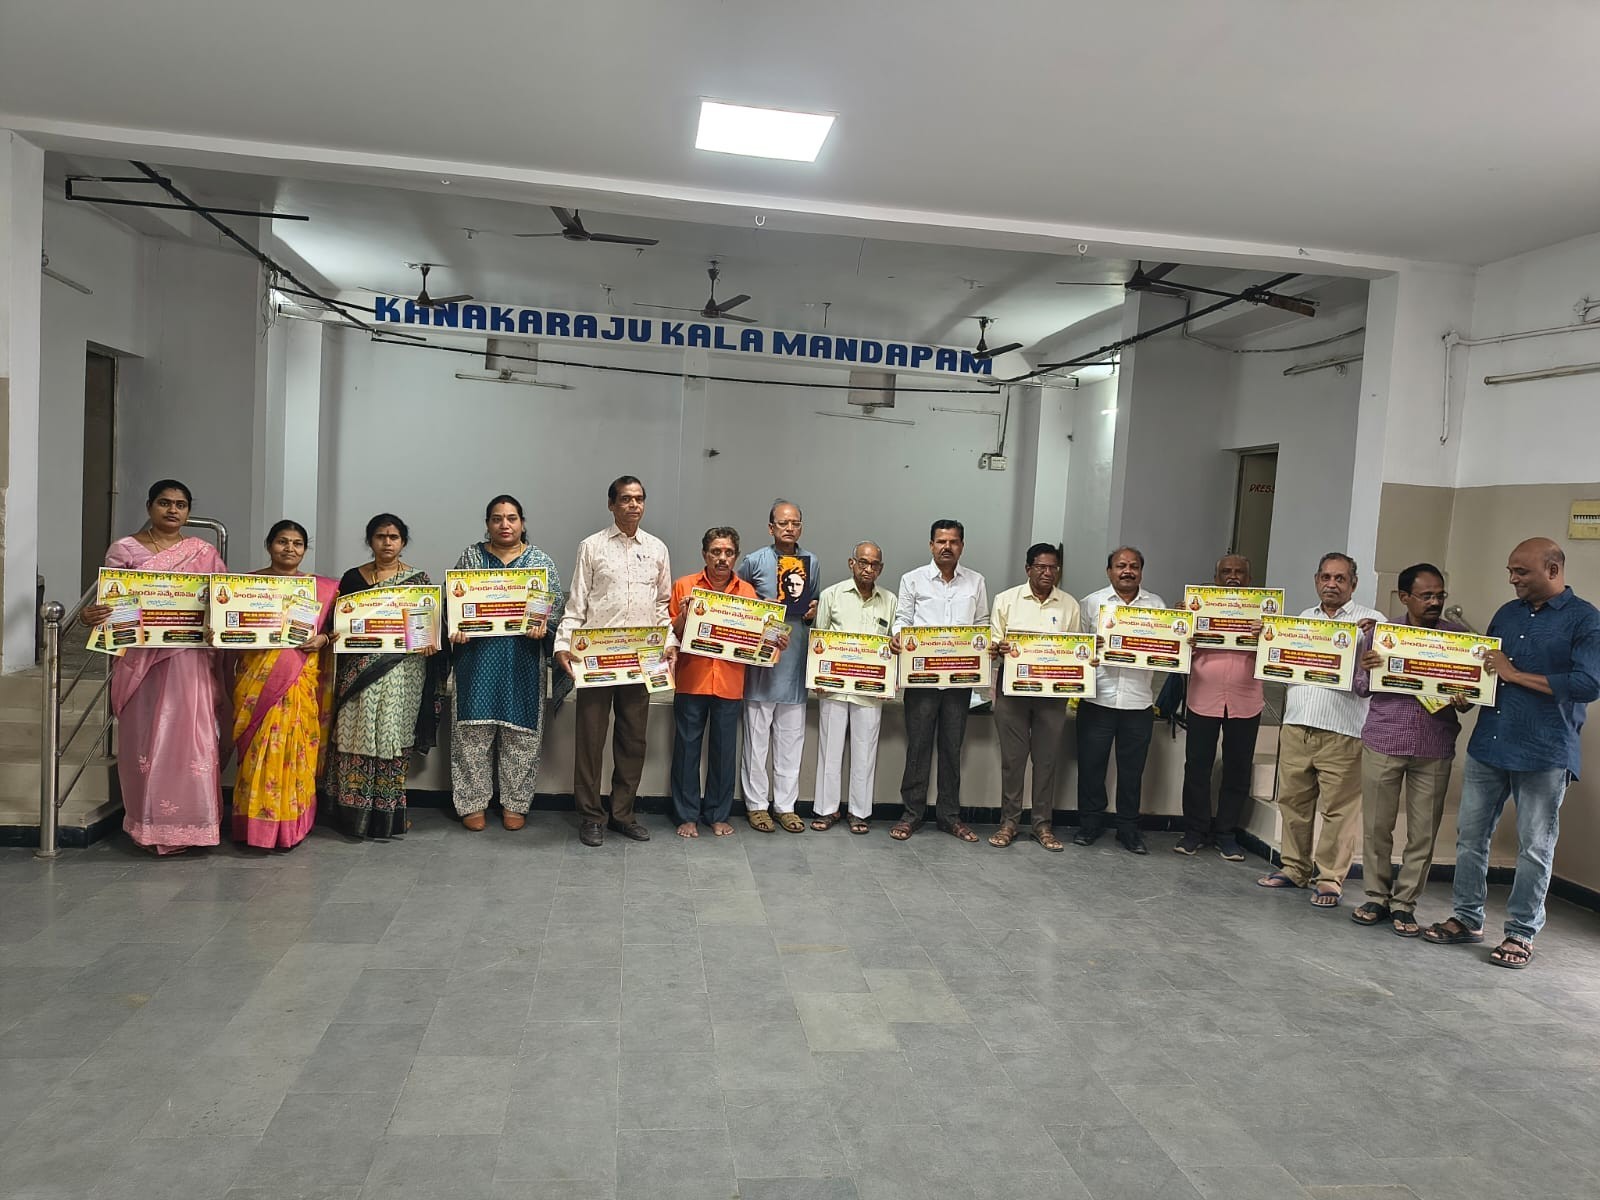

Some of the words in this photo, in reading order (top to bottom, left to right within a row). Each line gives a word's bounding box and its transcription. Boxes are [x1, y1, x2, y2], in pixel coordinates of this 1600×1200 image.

[375, 296, 652, 342] KANAKARAJU
[661, 321, 763, 352] KALA
[773, 331, 993, 375] MANDAPAM
